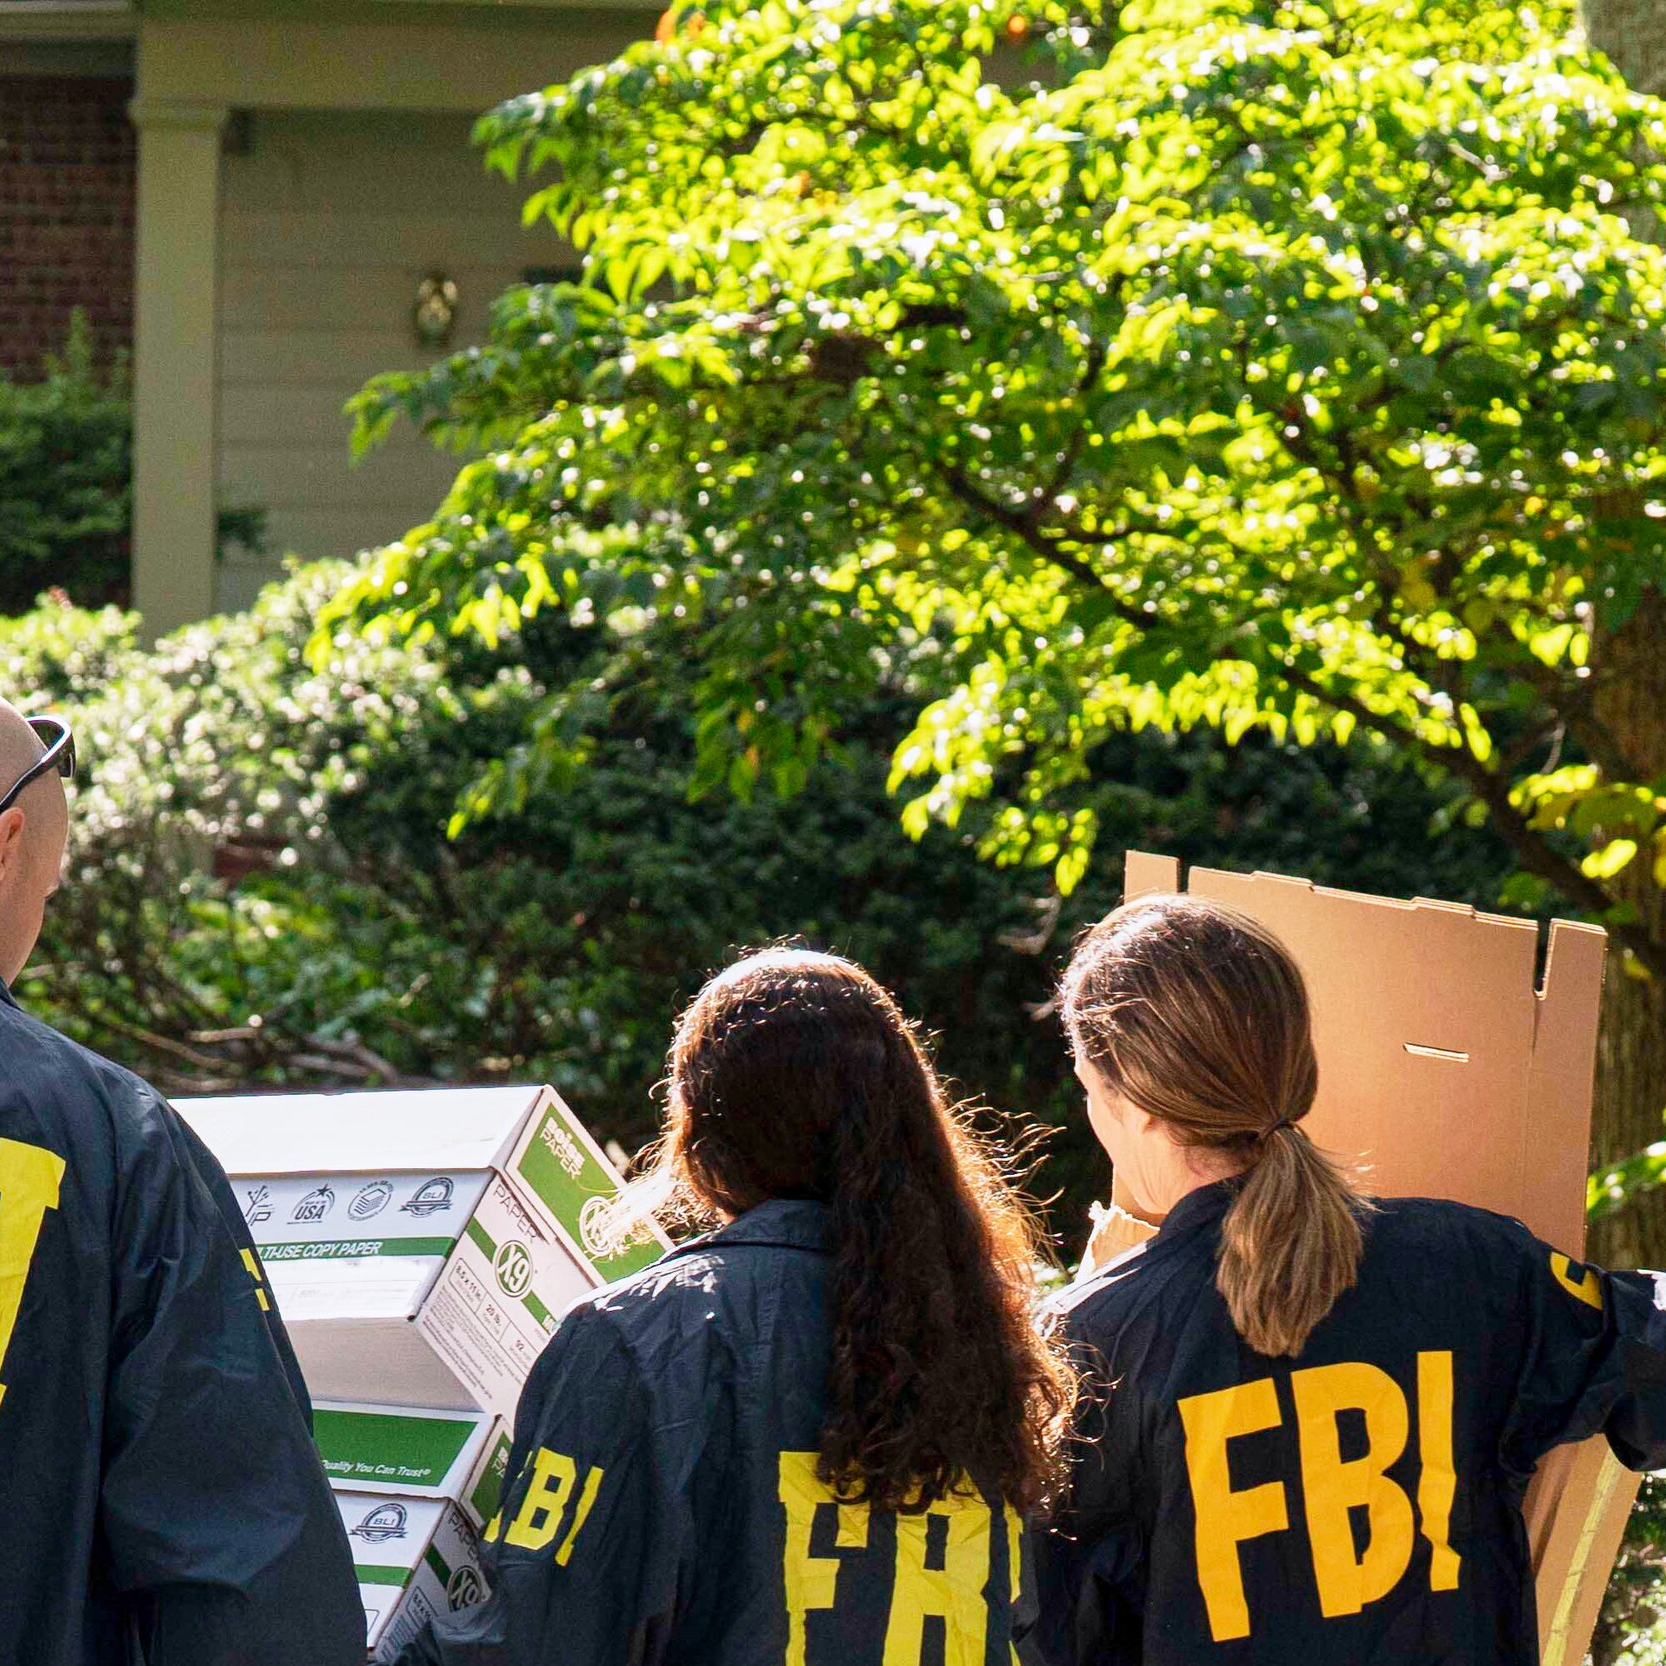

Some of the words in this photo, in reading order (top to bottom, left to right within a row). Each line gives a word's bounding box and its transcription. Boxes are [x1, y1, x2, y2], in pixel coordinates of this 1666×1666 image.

[539, 1127, 582, 1180] PAPER
[295, 1204, 326, 1220] USA
[492, 1183, 538, 1244] PAPER
[256, 1245, 304, 1259] LTI-USE
[303, 1243, 339, 1258] COPY
[336, 1241, 384, 1256] PAPER
[497, 1244, 530, 1293] X9
[354, 1461, 374, 1474] You
[374, 1464, 396, 1476] Can
[1177, 1350, 1462, 1643] FBI
[373, 1518, 396, 1526] BLI
[447, 1511, 479, 1562] PAPE
